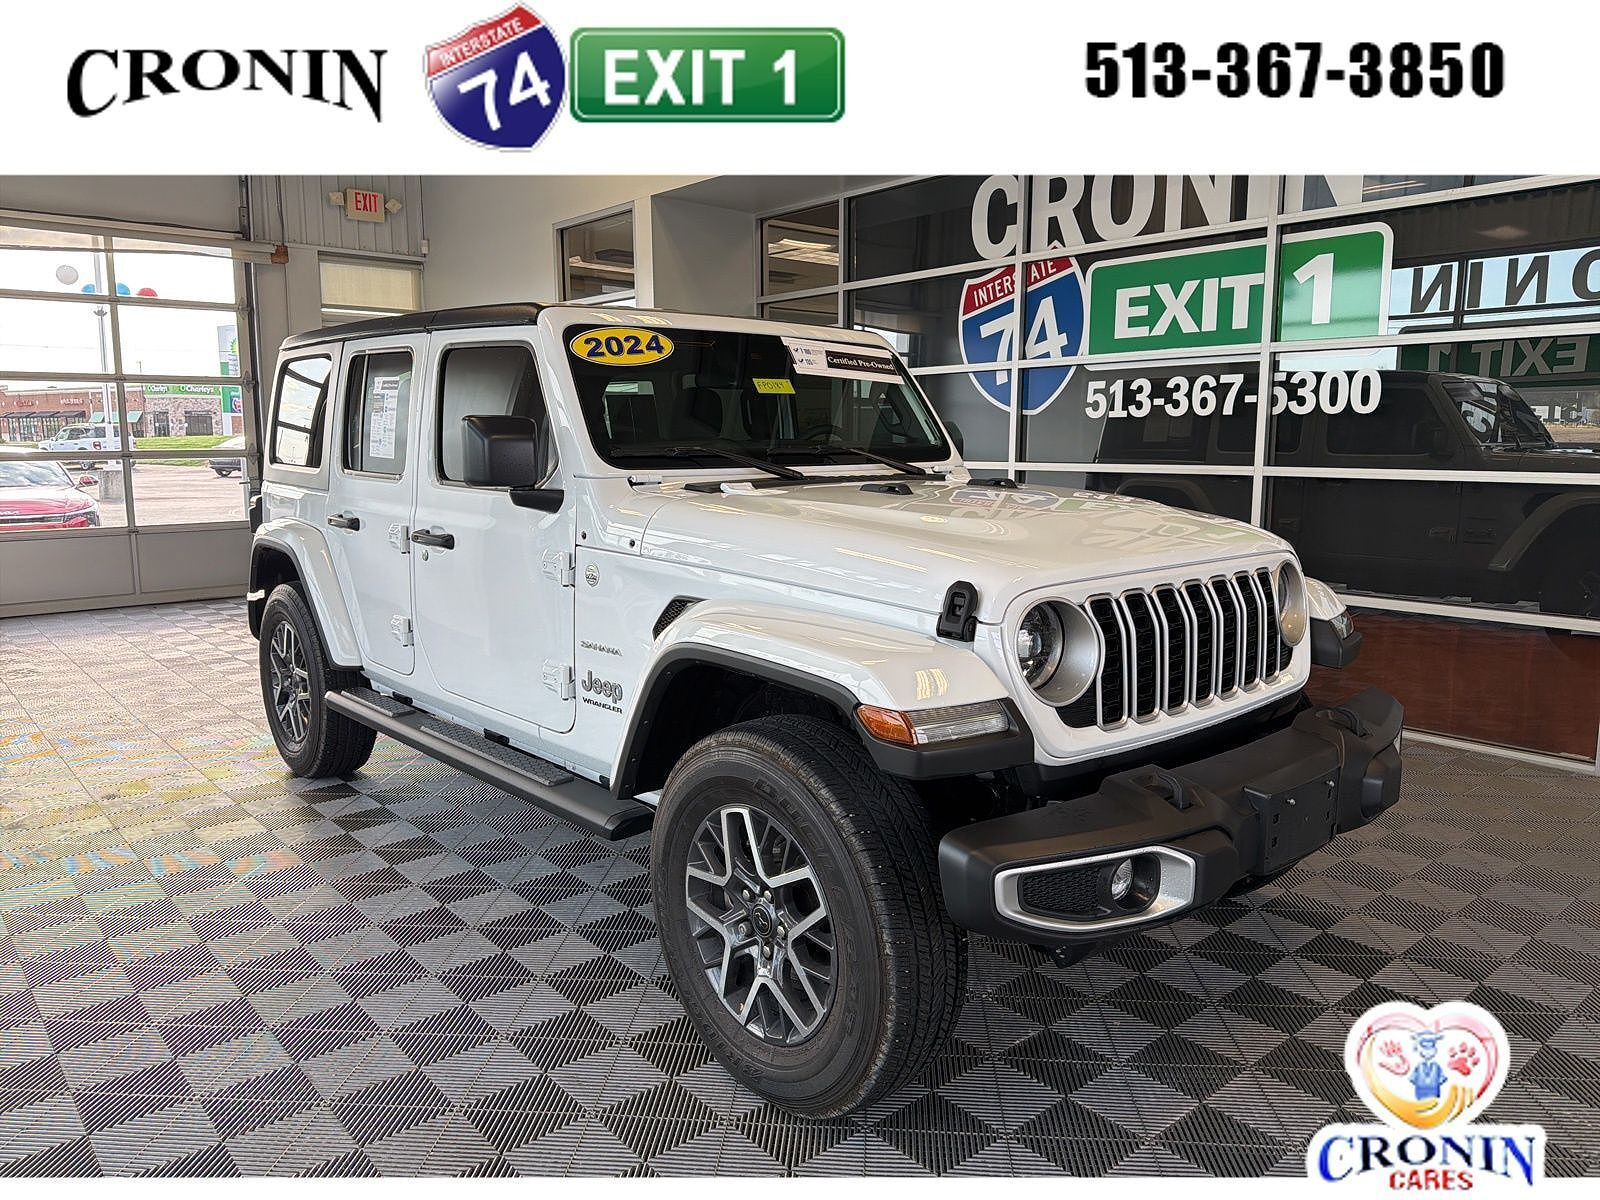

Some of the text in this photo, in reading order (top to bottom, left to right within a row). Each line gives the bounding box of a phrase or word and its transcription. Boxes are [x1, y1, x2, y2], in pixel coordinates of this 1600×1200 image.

[354, 192, 379, 213] EXIT
[1114, 253, 1334, 340] EXIT 1
[583, 334, 665, 358] 2024
[980, 296, 1068, 386] 74
[827, 355, 857, 367] Certified
[857, 359, 895, 371] Pre-Owned
[581, 669, 623, 705] Jeep
[582, 696, 623, 715] WRANGLER
